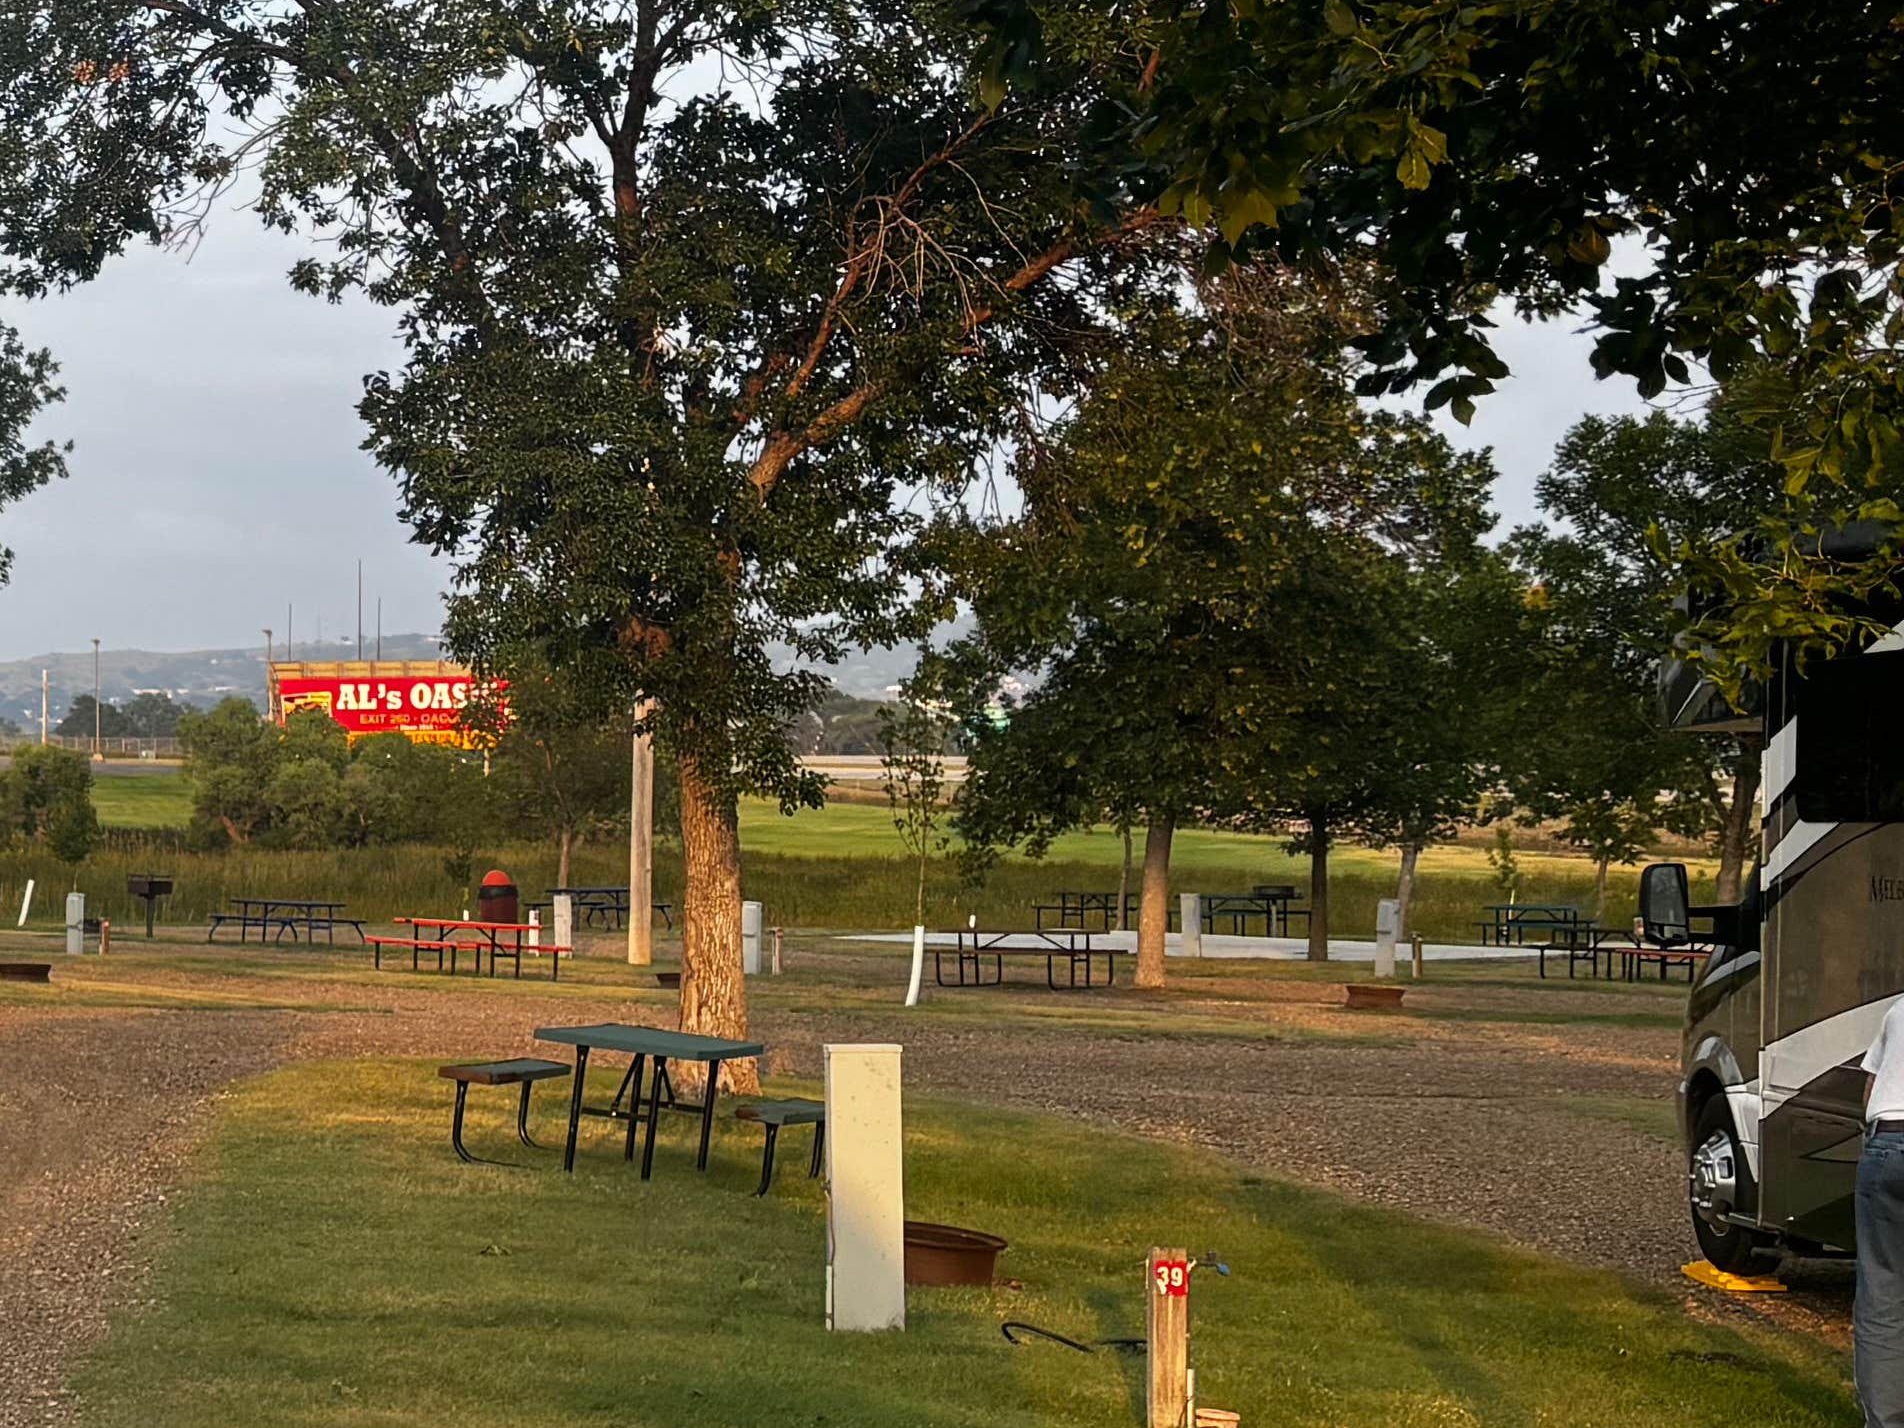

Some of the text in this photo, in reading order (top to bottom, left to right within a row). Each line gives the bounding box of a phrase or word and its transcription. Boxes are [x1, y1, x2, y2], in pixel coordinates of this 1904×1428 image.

[336, 683, 403, 710] AL's
[359, 713, 387, 725] EXIT
[1157, 1266, 1184, 1287] 39
